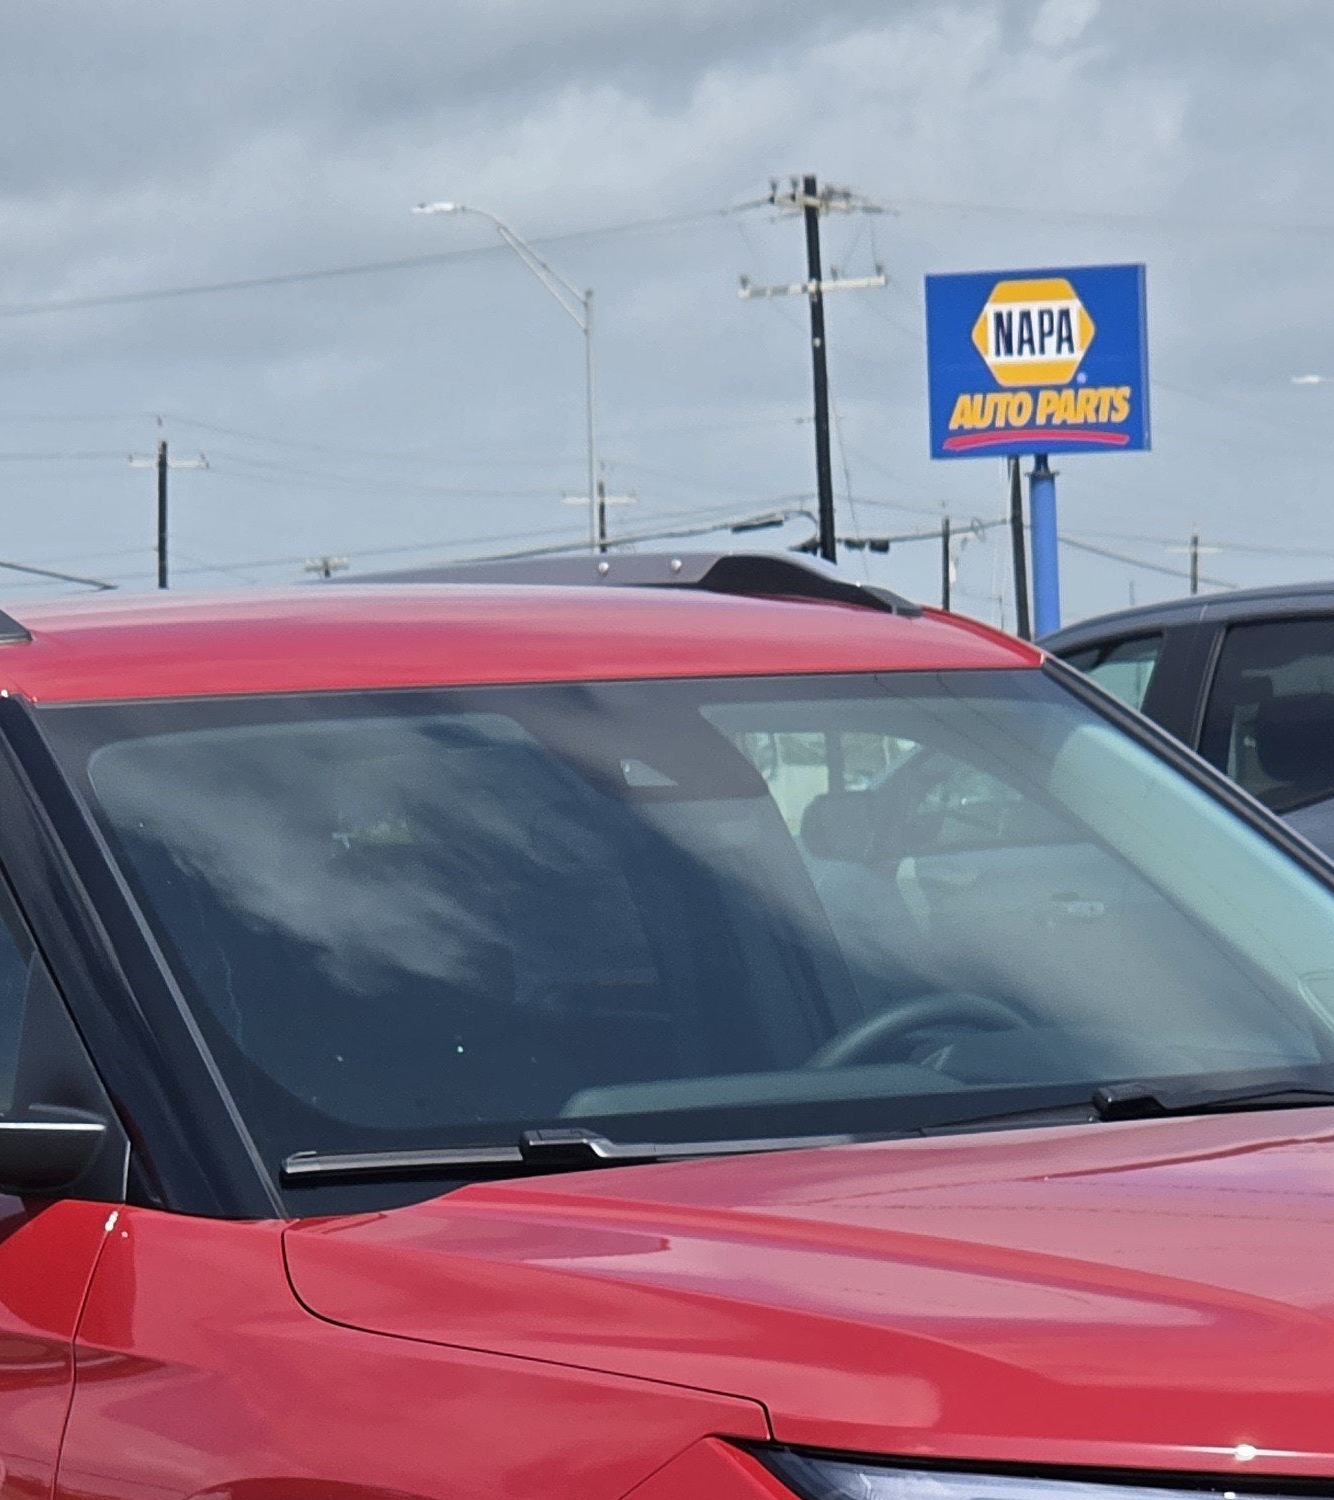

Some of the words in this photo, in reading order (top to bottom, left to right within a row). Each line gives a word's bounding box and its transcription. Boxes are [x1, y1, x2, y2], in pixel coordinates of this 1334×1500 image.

[993, 307, 1075, 358] NAPA
[949, 391, 1033, 430] AUTO
[1035, 386, 1131, 426] PARTS
